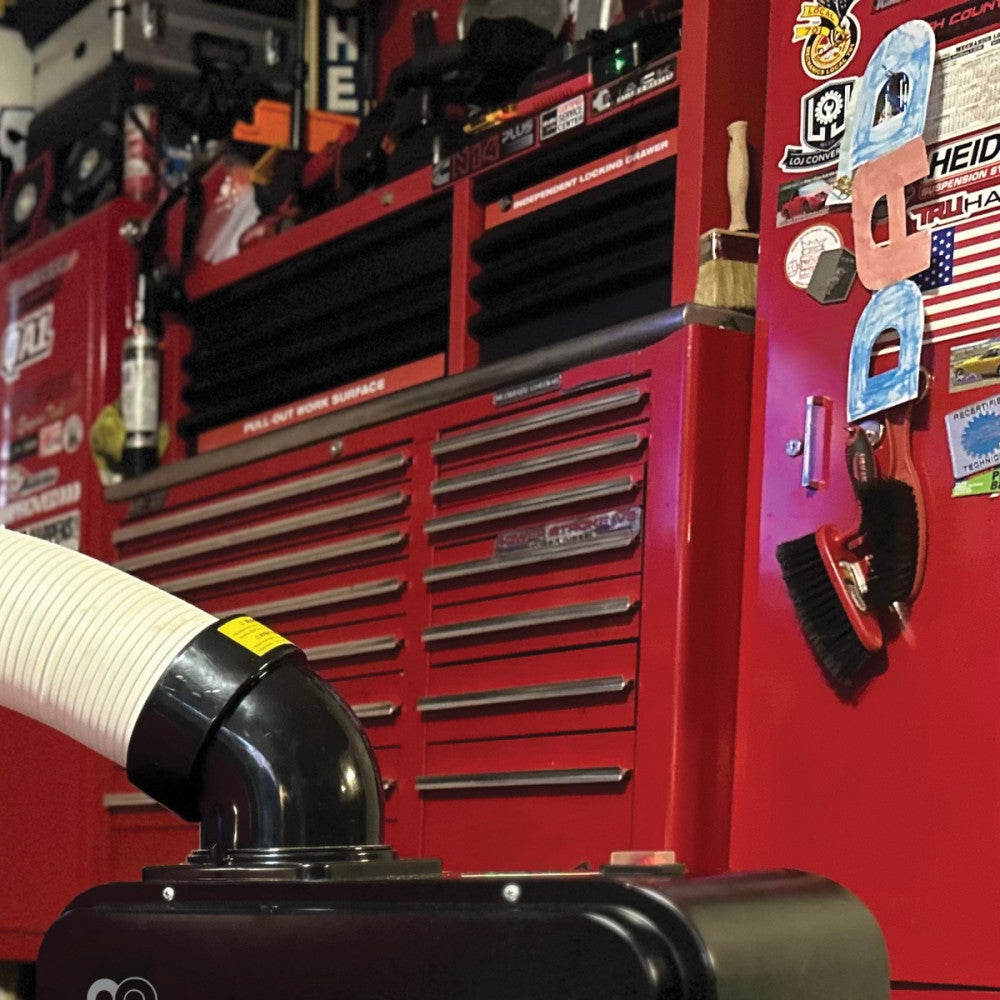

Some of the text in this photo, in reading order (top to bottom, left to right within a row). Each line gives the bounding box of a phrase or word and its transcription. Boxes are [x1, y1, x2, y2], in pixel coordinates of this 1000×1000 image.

[326, 0, 360, 113] HE
[513, 140, 669, 209] INDEPENDENT LOCKING DRAWER
[928, 133, 1000, 179] HEID
[243, 378, 386, 433] PULL-OUT WORK SURFACE
